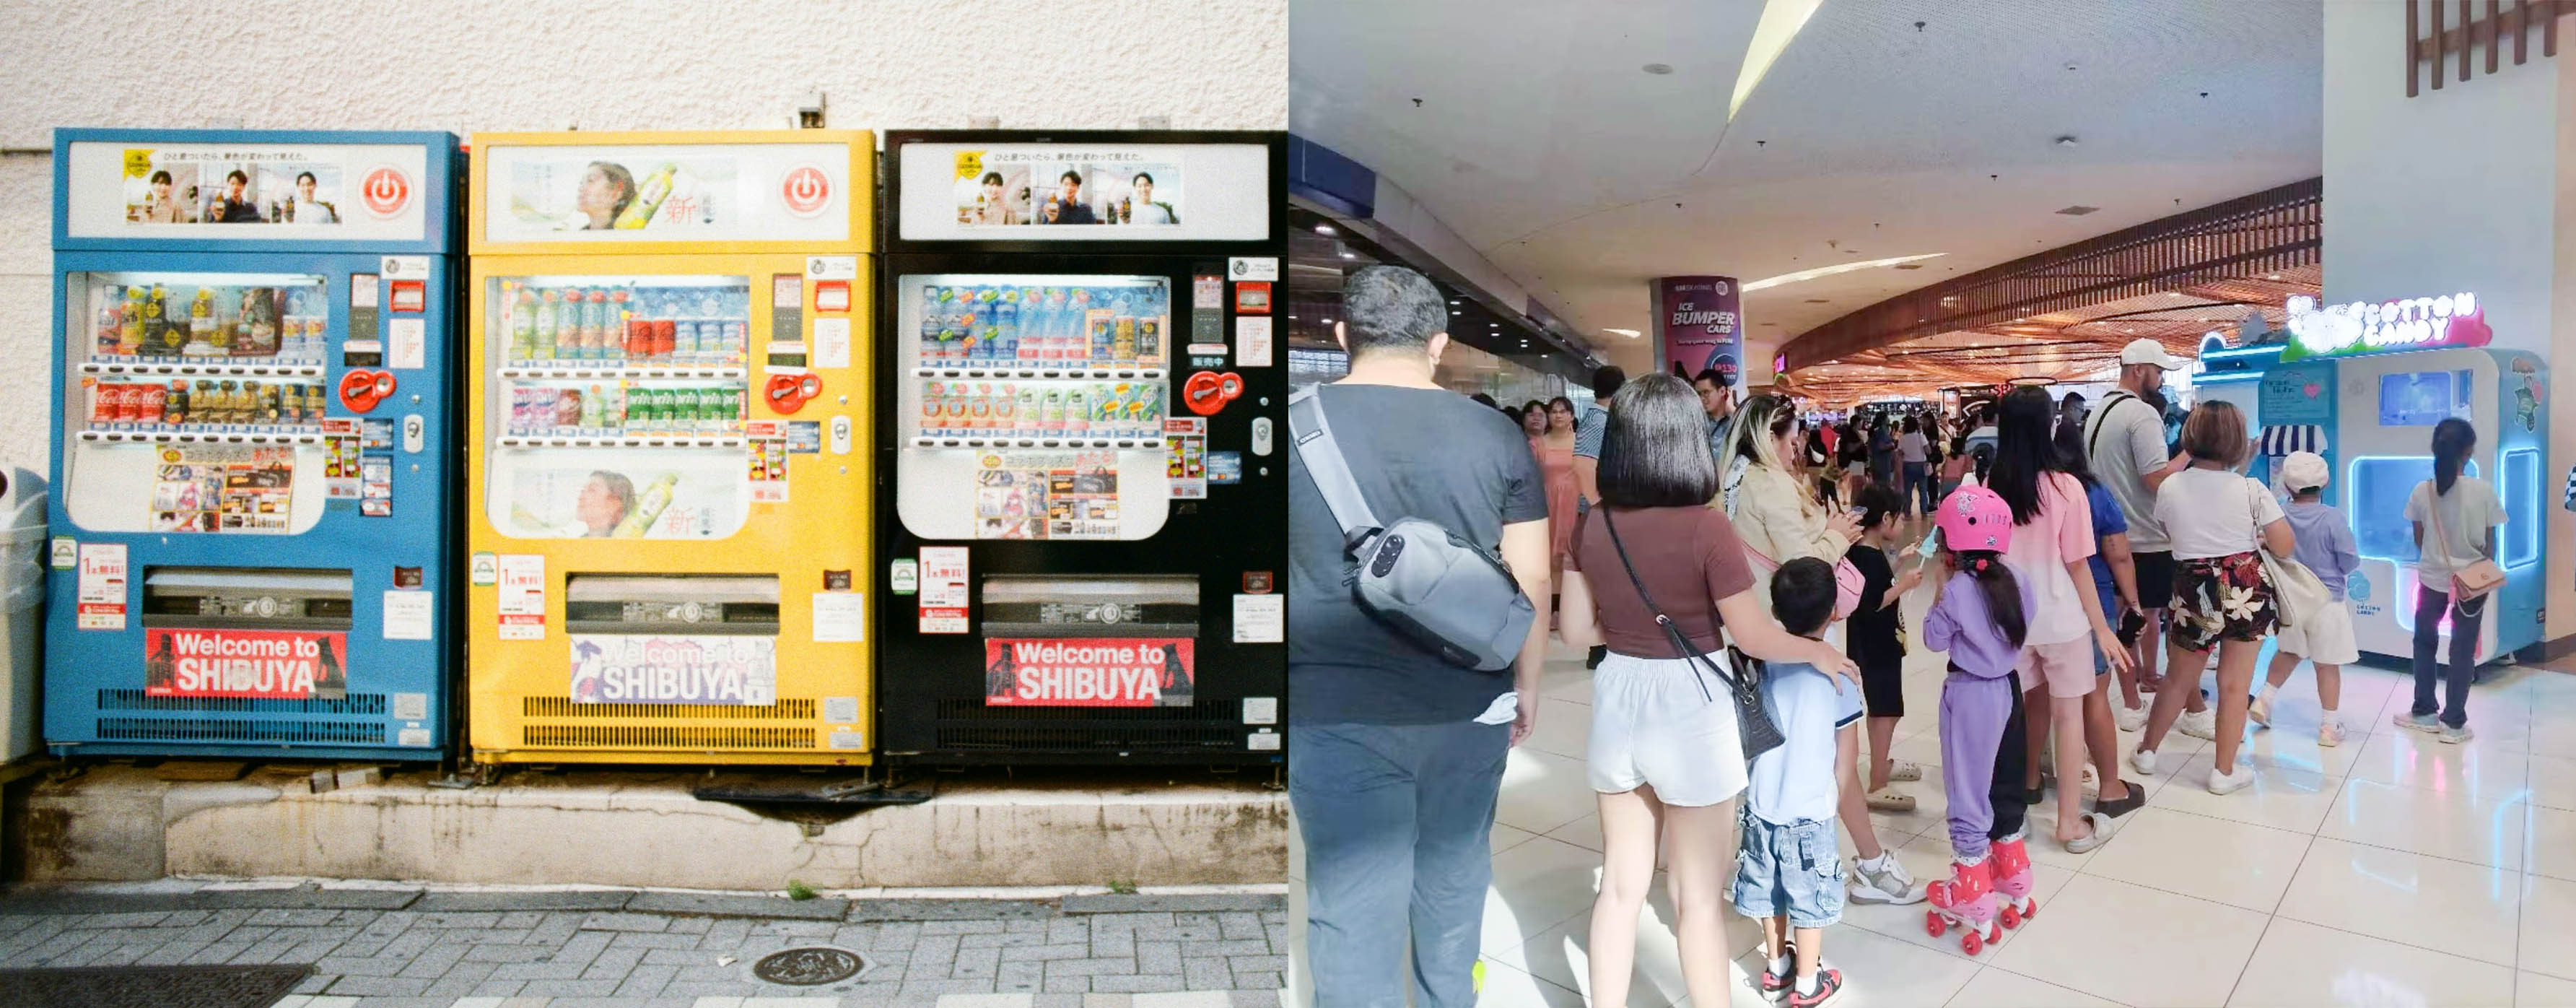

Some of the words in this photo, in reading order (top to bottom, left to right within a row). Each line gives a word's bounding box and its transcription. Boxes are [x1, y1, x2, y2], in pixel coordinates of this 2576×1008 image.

[665, 194, 697, 225] 新
[1672, 311, 1735, 325] BUMPER
[1678, 303, 1694, 311] ICE
[2364, 292, 2477, 326] COTTON
[1706, 325, 1732, 334] CARS
[2364, 316, 2450, 346] CANDY
[1192, 357, 1224, 367] 販売中
[175, 633, 289, 656] Welcome
[294, 636, 319, 658] to
[601, 641, 717, 664] Welcome
[721, 643, 749, 664] to
[1016, 642, 1134, 664] Welcome
[1139, 644, 1166, 664] to
[178, 657, 316, 692] SHIBUYA
[603, 666, 743, 700] SHIBUYA
[1018, 666, 1162, 700] SHIBUYA
